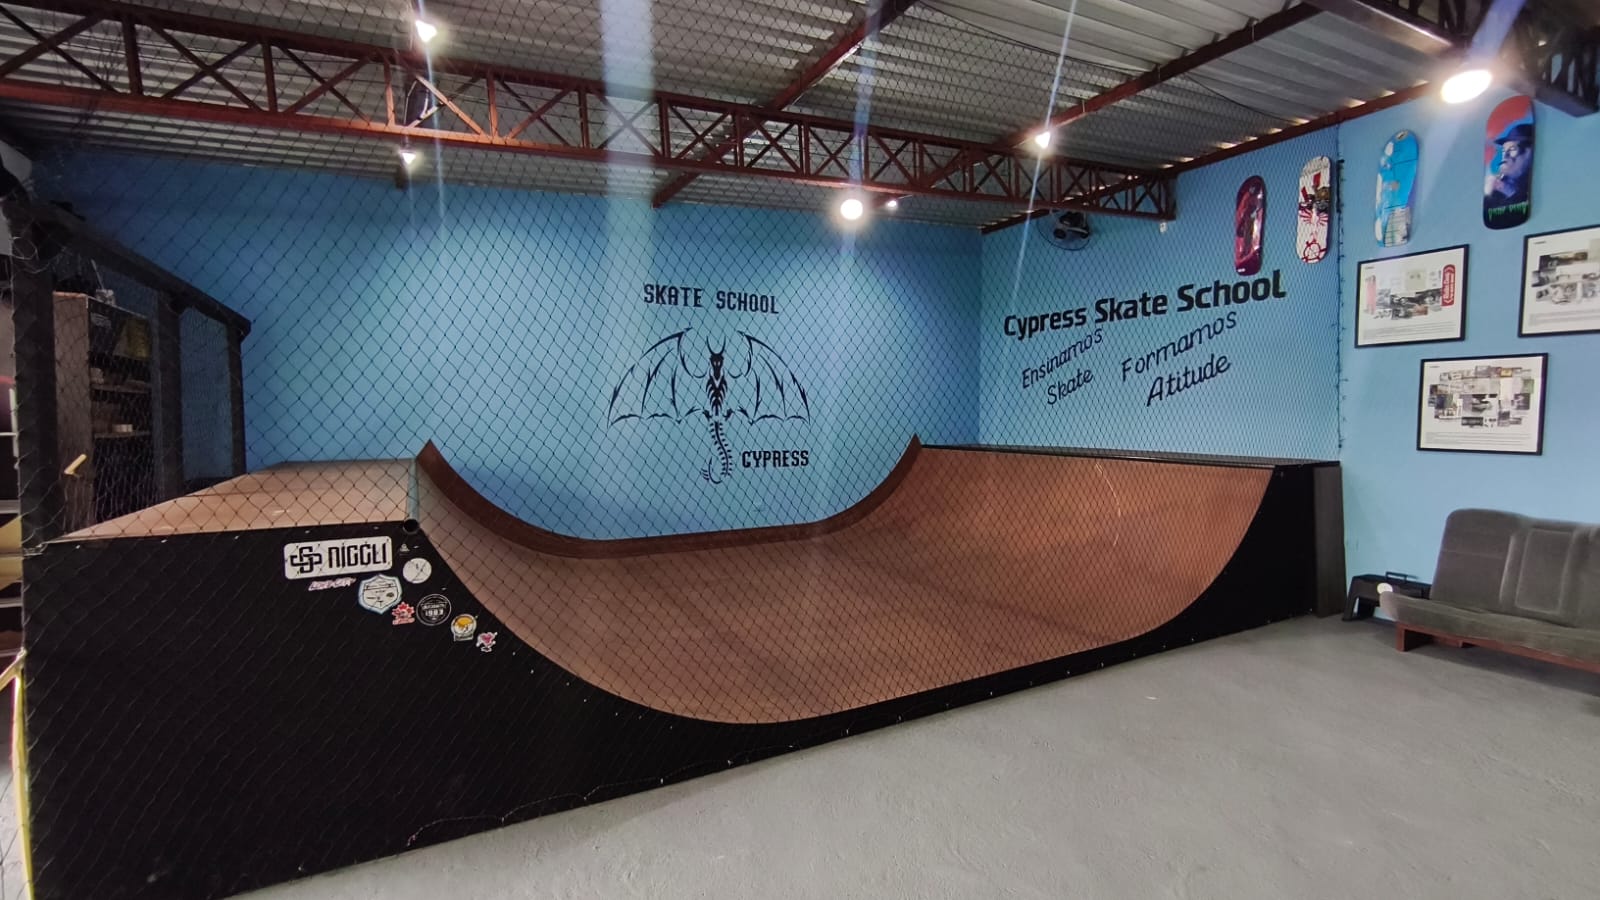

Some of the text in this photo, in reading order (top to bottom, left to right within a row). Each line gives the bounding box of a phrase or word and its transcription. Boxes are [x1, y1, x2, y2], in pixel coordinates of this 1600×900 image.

[643, 283, 780, 314] SKATE SCHOOL
[1004, 269, 1287, 341] Cypress Skate School
[1022, 328, 1104, 389] Ensinamos
[1120, 311, 1237, 382] Formamos
[1046, 368, 1094, 405] Skate
[1145, 353, 1232, 407] Atitude
[741, 449, 810, 469] CYPRESS
[328, 542, 387, 569] NIGGLI
